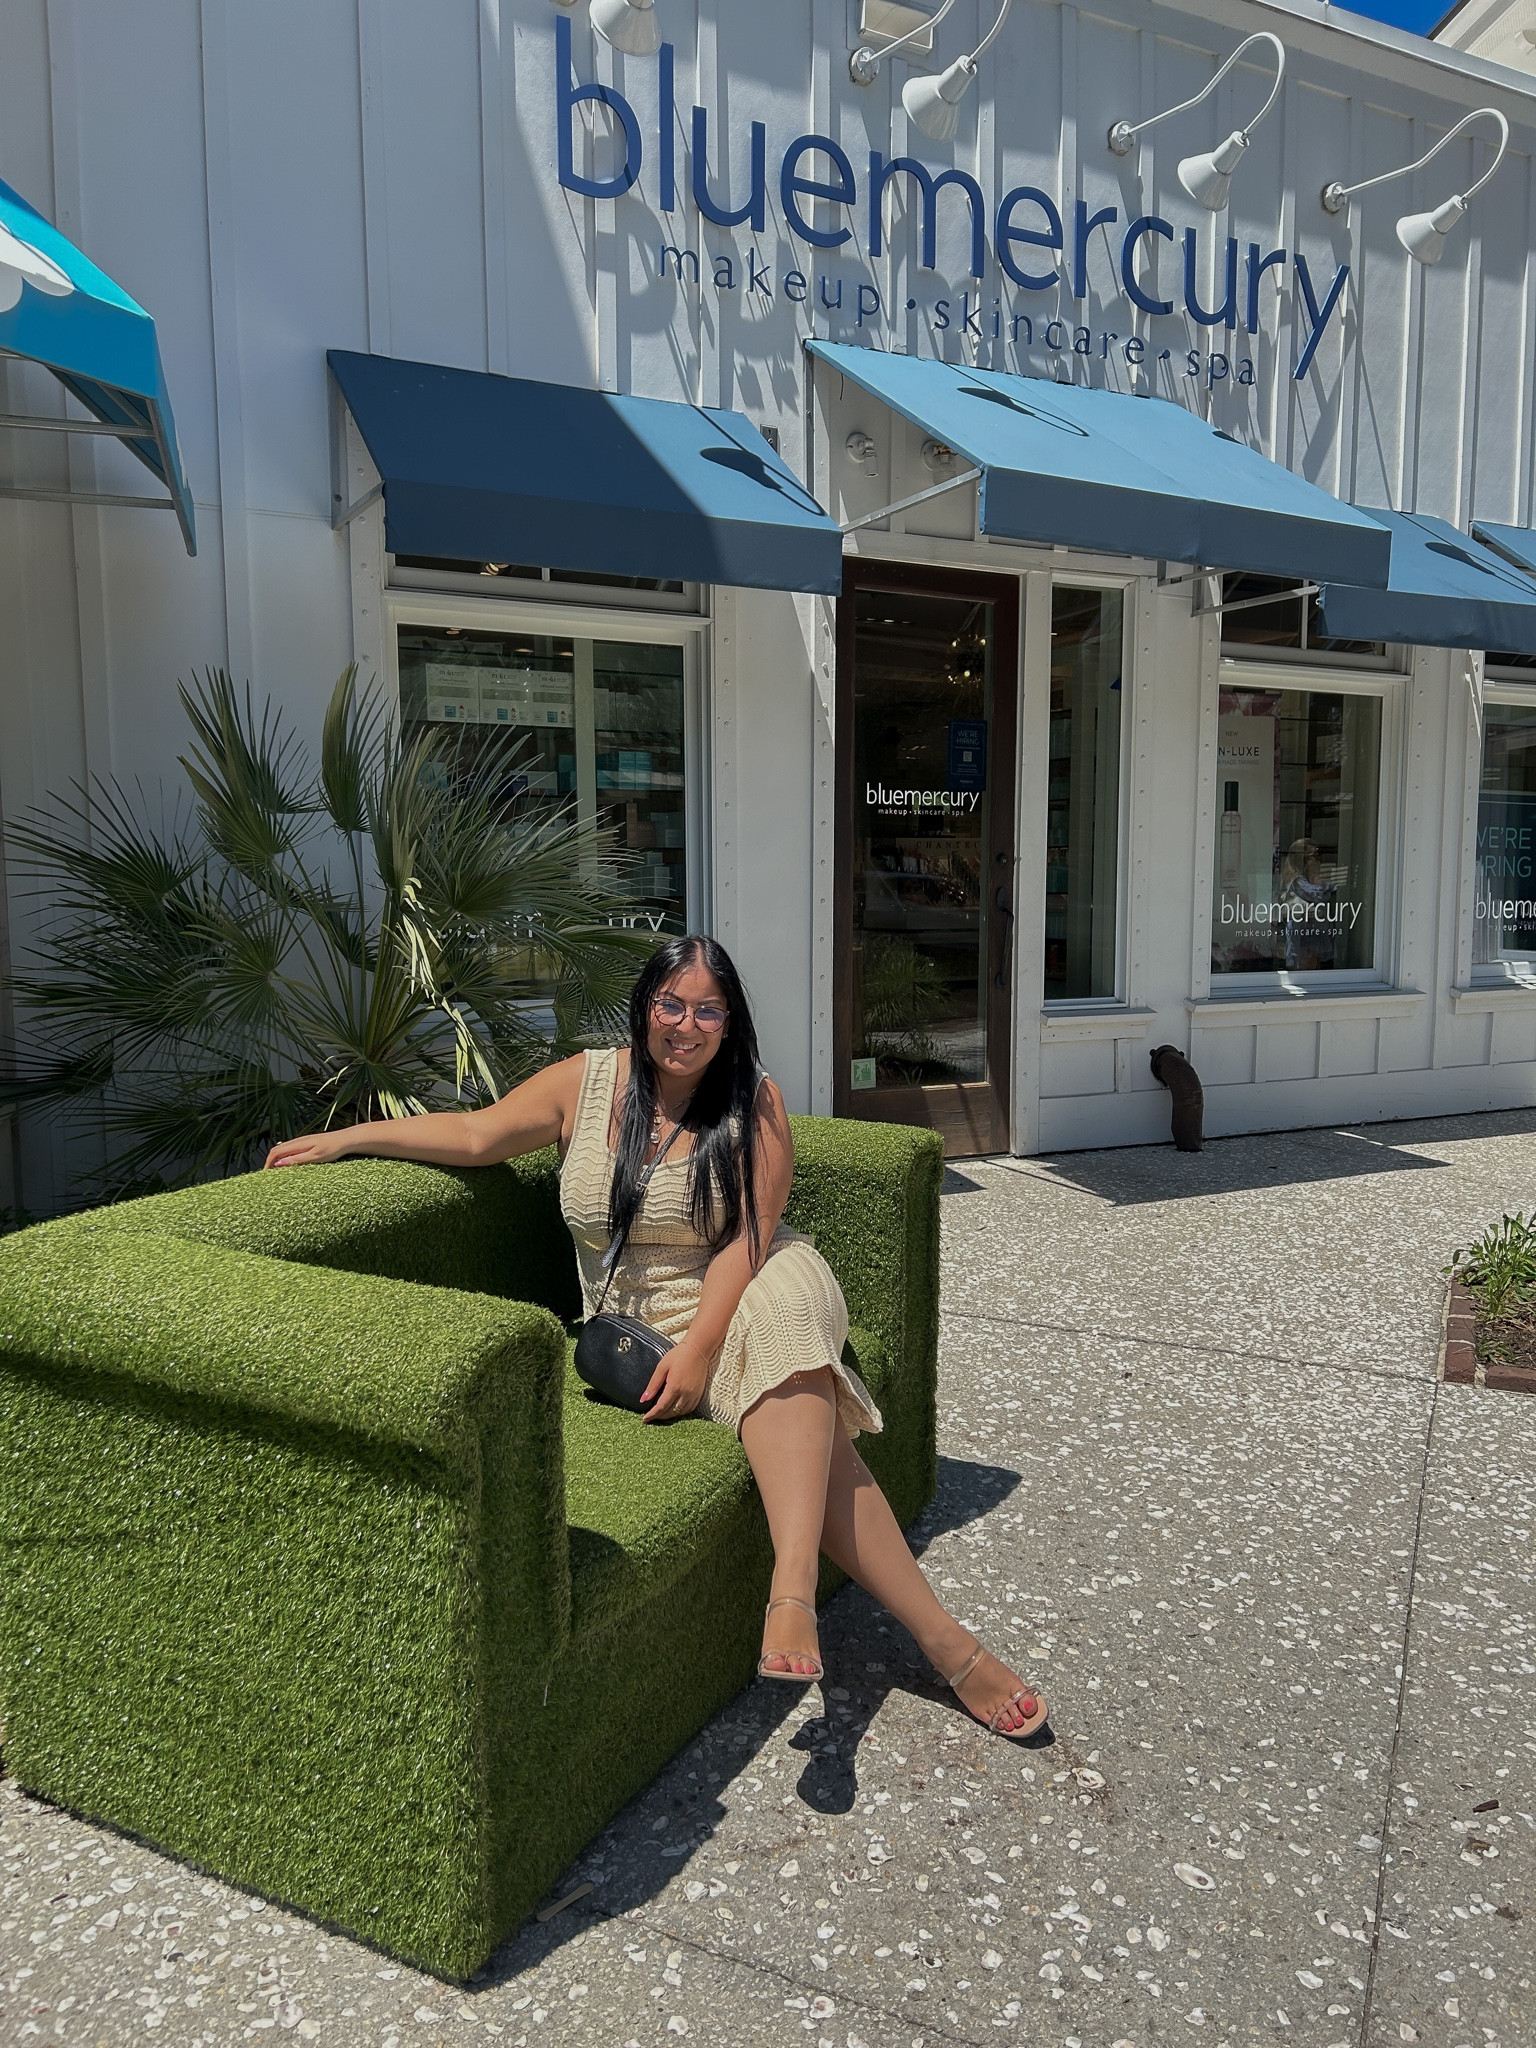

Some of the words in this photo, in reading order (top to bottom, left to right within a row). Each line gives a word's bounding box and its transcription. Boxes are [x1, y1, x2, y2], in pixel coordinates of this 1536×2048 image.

[556, 15, 1351, 381] bluemercury
[660, 242, 880, 328] makeup
[933, 291, 1145, 366] skincare
[1185, 348, 1256, 390] spa
[957, 730, 980, 738] WE'RE
[956, 737, 980, 745] HIRING
[1218, 746, 1260, 756] N-LUXE
[866, 782, 980, 812] bluemercury
[878, 808, 908, 817] makeup
[913, 808, 945, 816] skincare
[951, 810, 964, 818] spa
[1221, 894, 1363, 930] bluemercury
[1235, 928, 1272, 938] makeup
[1280, 927, 1320, 937] skincare
[1327, 927, 1343, 938] spa
